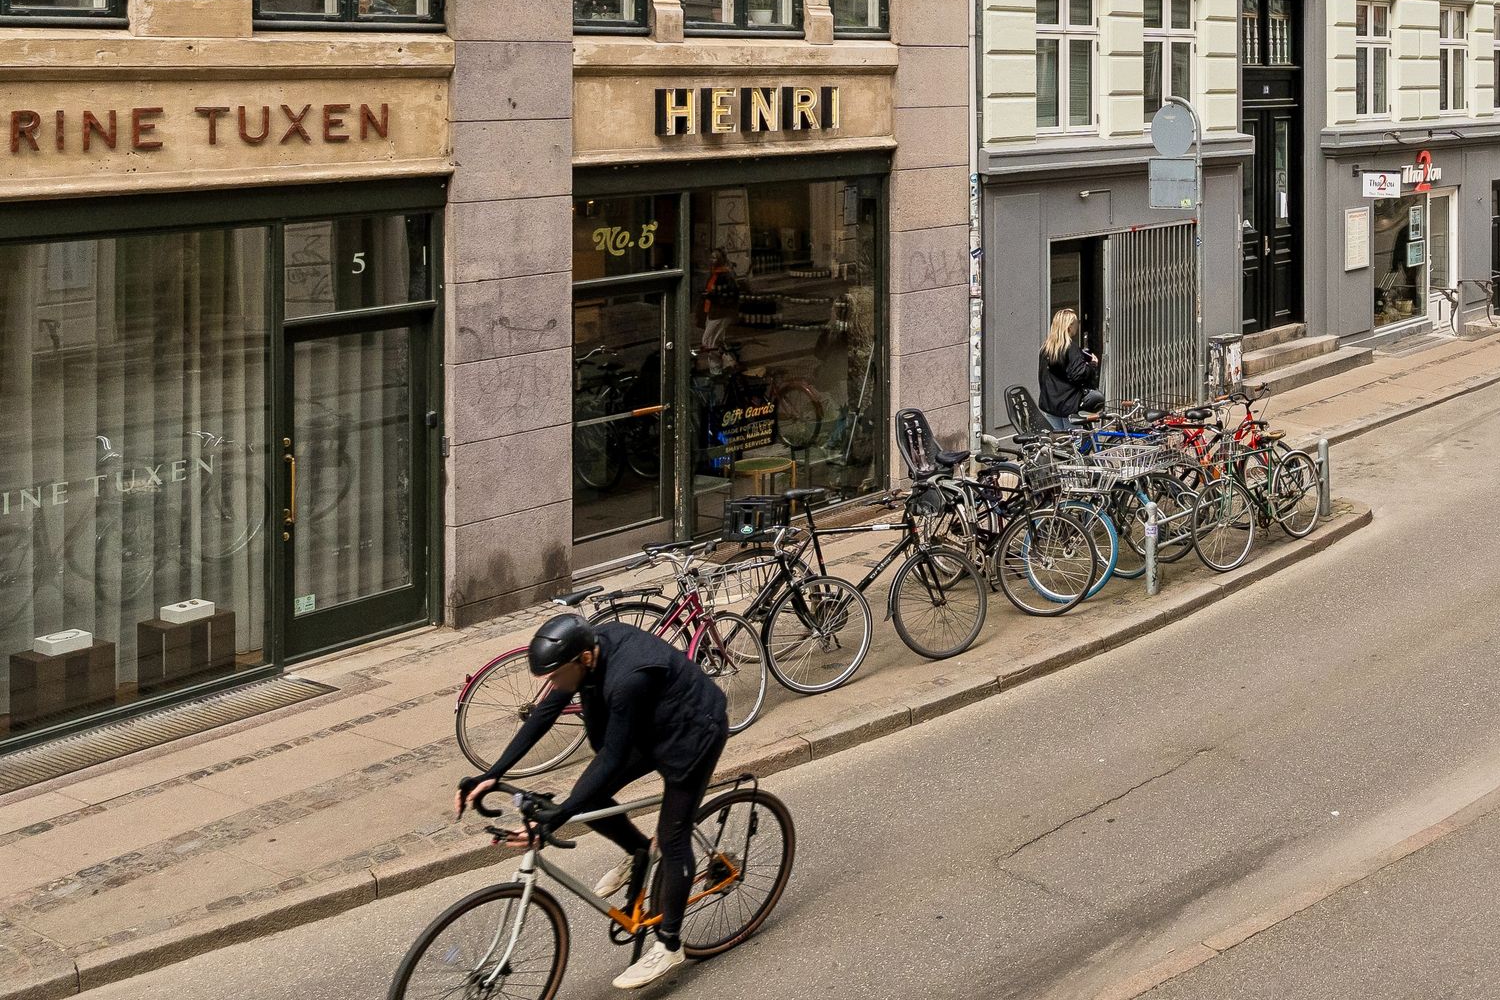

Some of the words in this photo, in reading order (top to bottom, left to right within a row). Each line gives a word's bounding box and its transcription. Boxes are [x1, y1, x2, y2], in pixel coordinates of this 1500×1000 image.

[11, 107, 163, 153] RINE
[194, 103, 389, 146] TUXEN
[655, 86, 840, 136] HENRI
[592, 226, 635, 256] No.
[637, 220, 659, 250] 5
[351, 252, 366, 275] 5
[721, 408, 744, 427] Gift
[744, 402, 775, 419] Cards
[744, 438, 771, 449] SERVICES
[1, 482, 69, 514] INE
[86, 455, 215, 498] TUXEN
